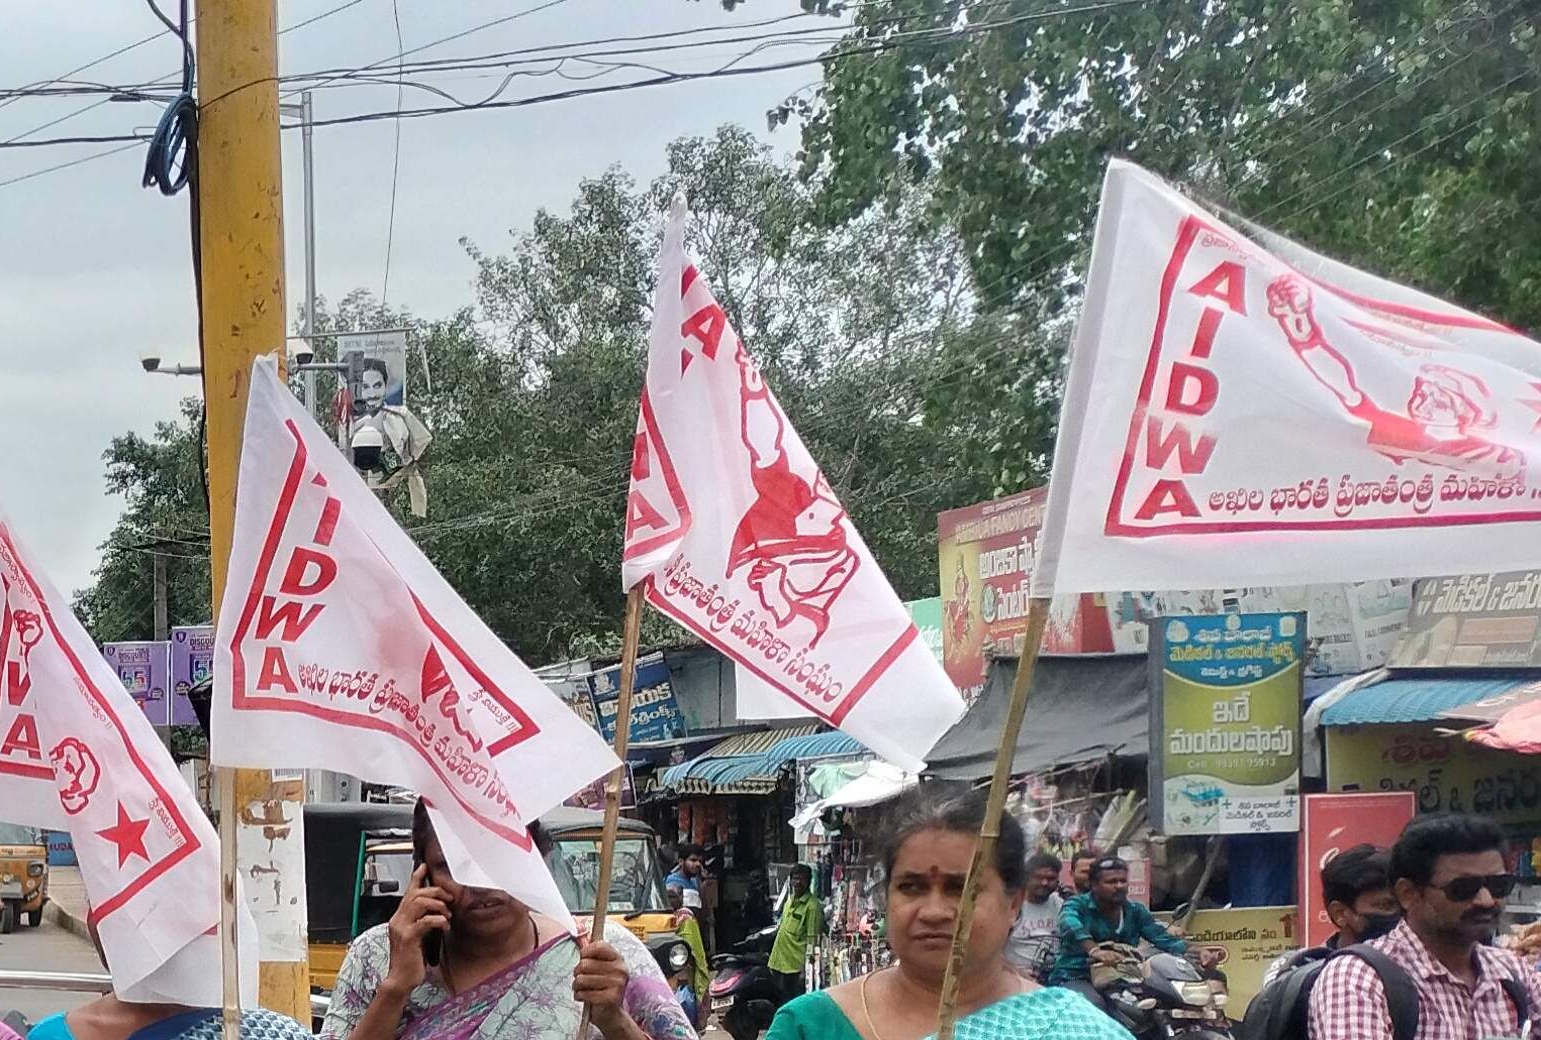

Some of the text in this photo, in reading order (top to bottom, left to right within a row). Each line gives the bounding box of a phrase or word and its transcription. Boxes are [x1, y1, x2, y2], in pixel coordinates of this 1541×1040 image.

[1133, 260, 1248, 521] AIDWA
[1208, 485, 1265, 516] అఖిల
[1269, 478, 1330, 517] భారత
[1333, 473, 1436, 519] ప్రజాతంత్ర
